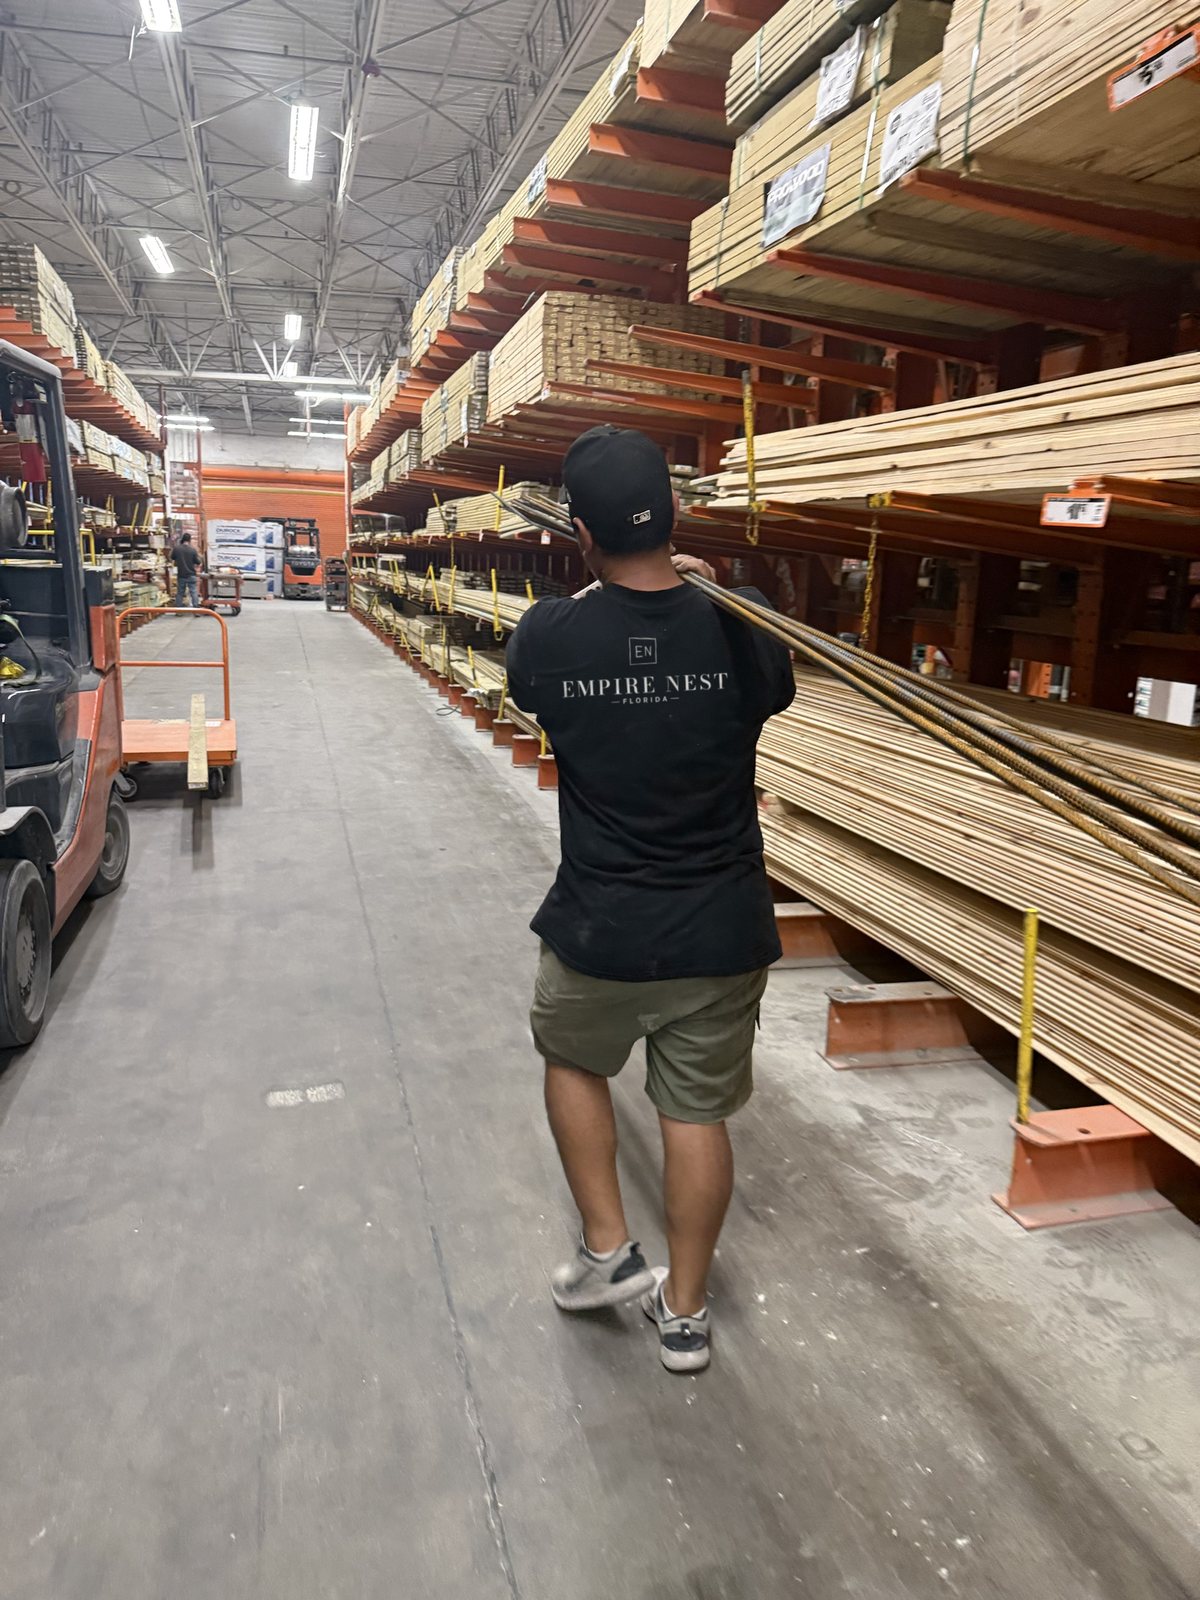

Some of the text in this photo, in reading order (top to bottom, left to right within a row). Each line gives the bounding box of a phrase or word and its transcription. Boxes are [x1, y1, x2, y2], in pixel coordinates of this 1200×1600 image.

[635, 645, 652, 658] EN
[562, 672, 729, 698] EMPIRE NEST
[622, 696, 668, 704] FLORIDA
